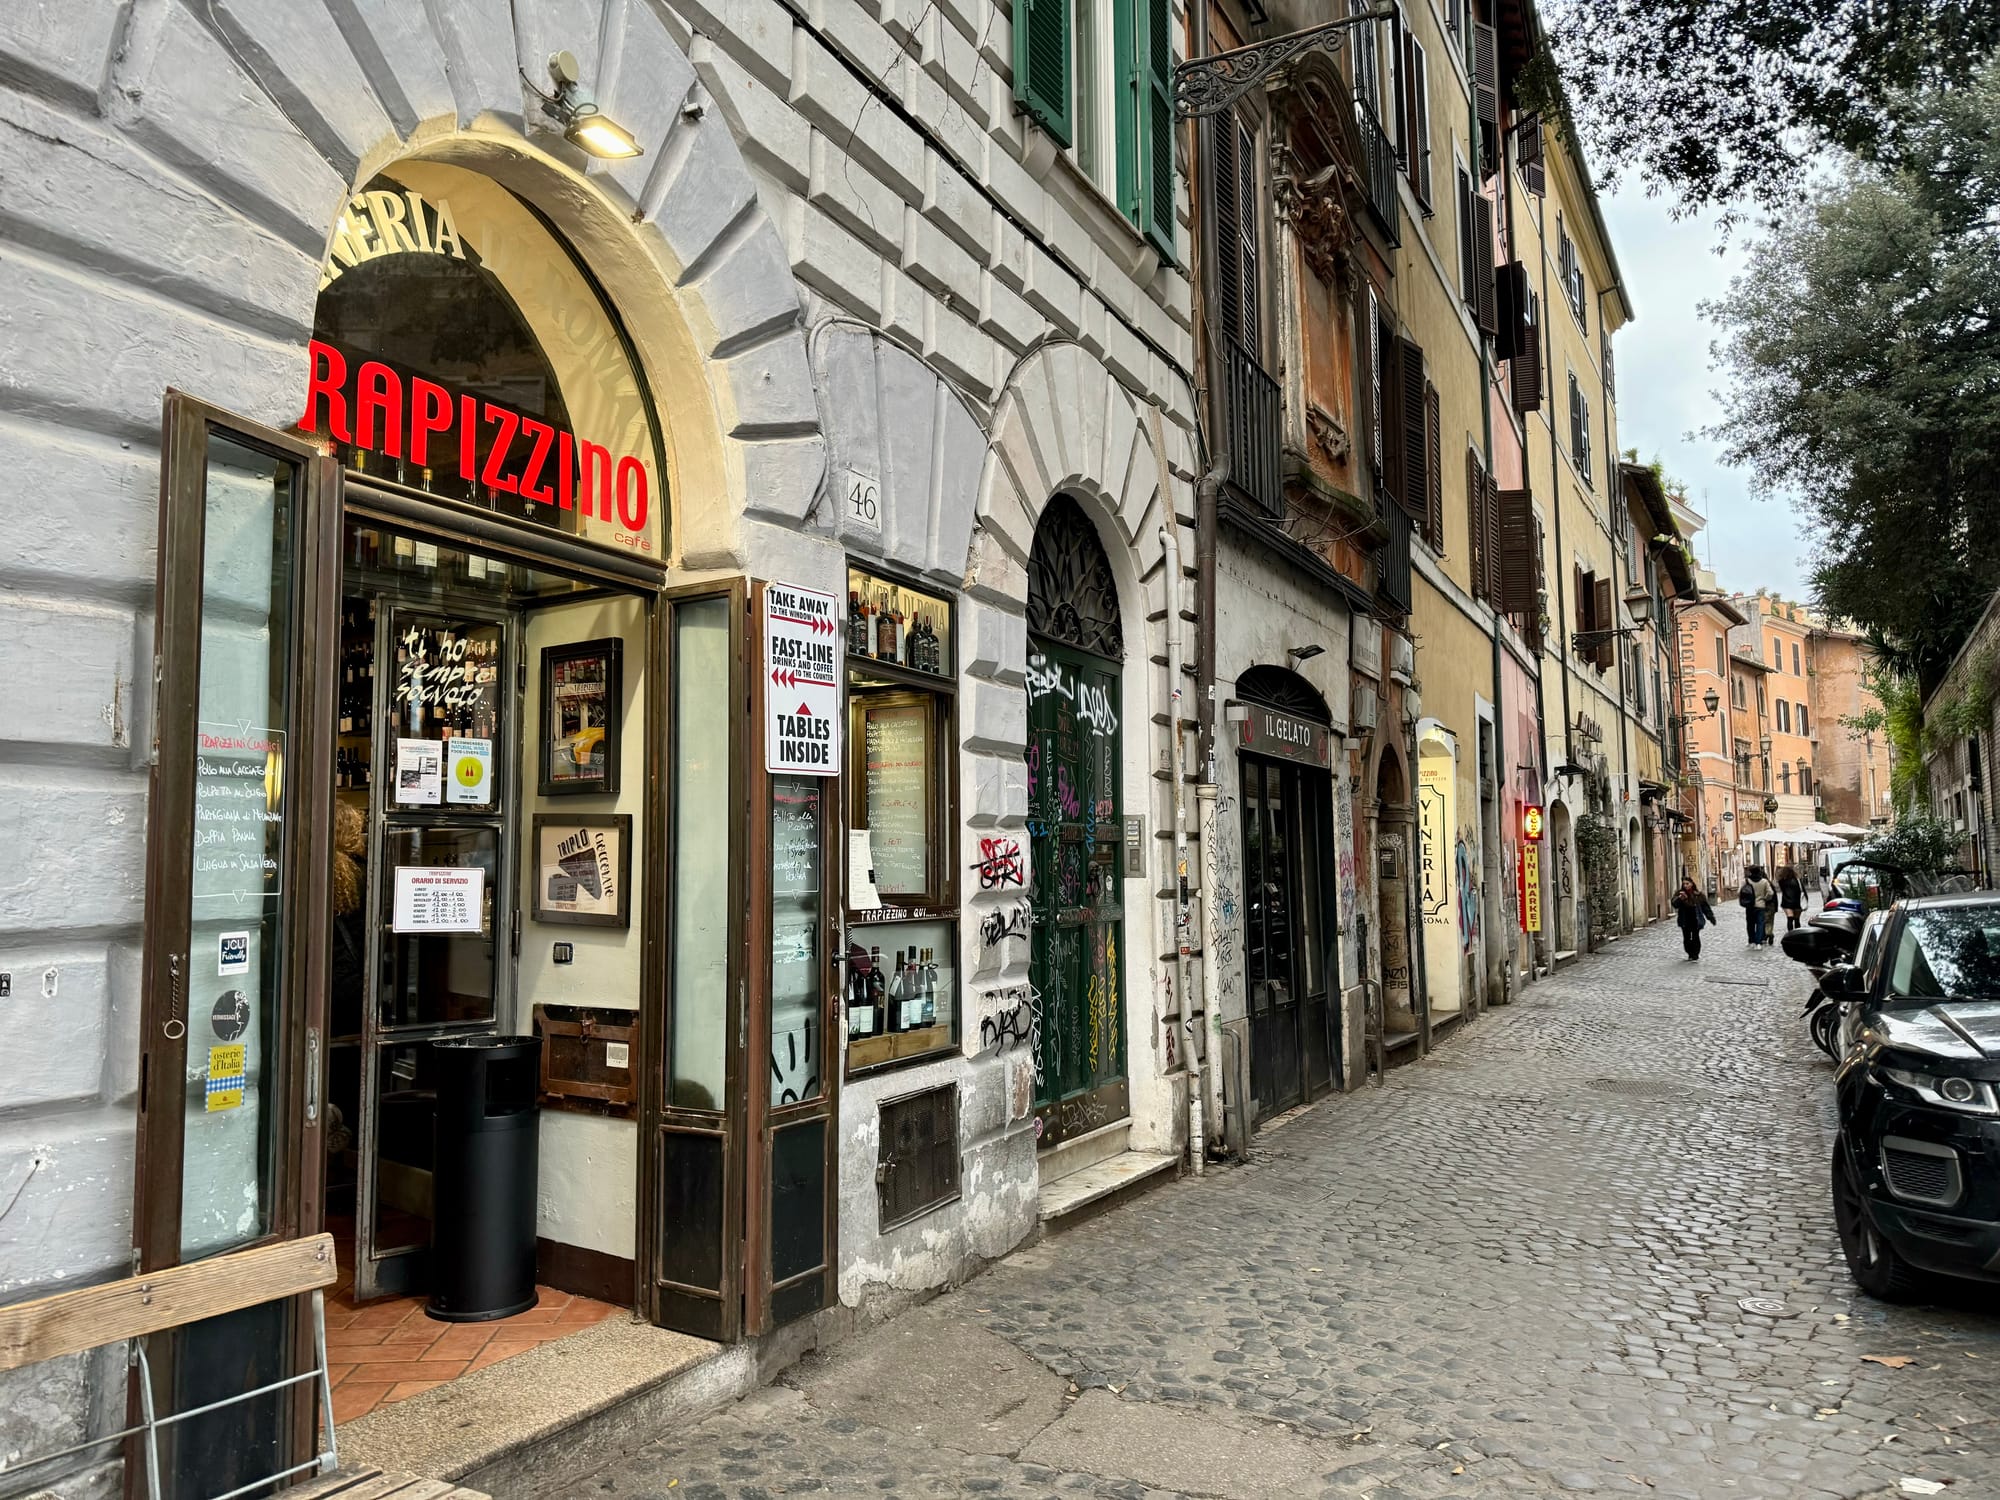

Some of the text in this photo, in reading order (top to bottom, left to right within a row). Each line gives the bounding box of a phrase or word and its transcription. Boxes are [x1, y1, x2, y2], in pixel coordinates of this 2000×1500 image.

[319, 189, 466, 292] NERIA
[849, 481, 877, 520] 46
[770, 590, 828, 616] TAKE AWAY
[779, 608, 788, 616] THE
[789, 609, 812, 621] WINDOW
[405, 625, 467, 662] ti ho
[772, 636, 833, 664] FAST-LINE
[773, 655, 833, 674] DRINKS AND COFFEE
[796, 669, 834, 682] TO THE COUNTER
[778, 714, 830, 741] TABLES
[1265, 714, 1311, 747] IL GELATO
[780, 740, 829, 764] INSIDE
[557, 828, 588, 857] TRIPLO
[1420, 800, 1434, 902] VINERIA
[1526, 847, 1536, 877] MINI
[411, 877, 434, 885] ORARIO
[861, 908, 907, 921] TRAPIZZINO
[1527, 883, 1537, 928] MARKET
[221, 950, 246, 961] Friendly
[224, 939, 245, 951] JCU
[213, 1050, 241, 1060] osterie
[213, 1058, 241, 1071] d'Italia
